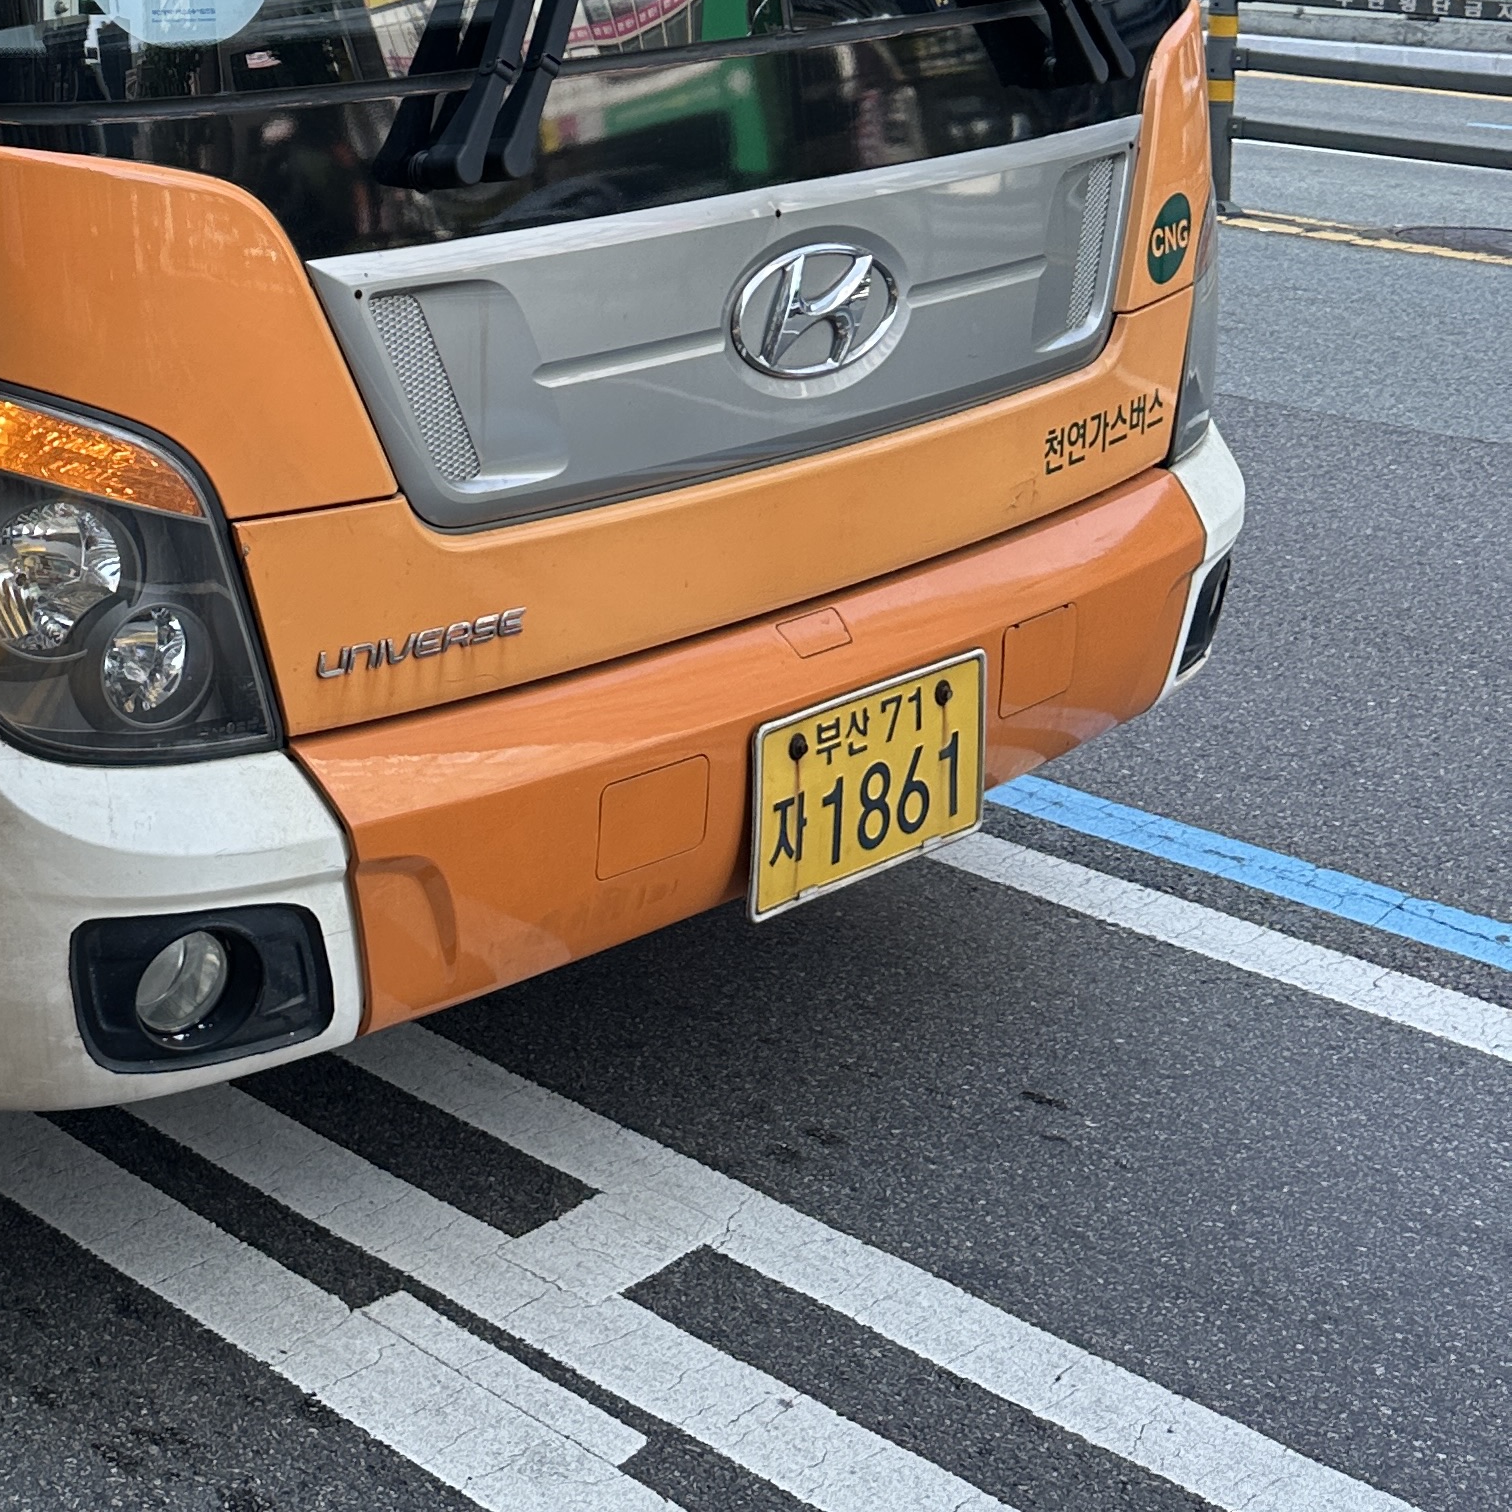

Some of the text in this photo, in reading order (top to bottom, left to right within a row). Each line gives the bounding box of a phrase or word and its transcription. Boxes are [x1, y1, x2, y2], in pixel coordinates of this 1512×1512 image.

[1150, 217, 1189, 259] CNG
[1044, 387, 1165, 477] 천연가스버스
[815, 685, 922, 766] 부산 71
